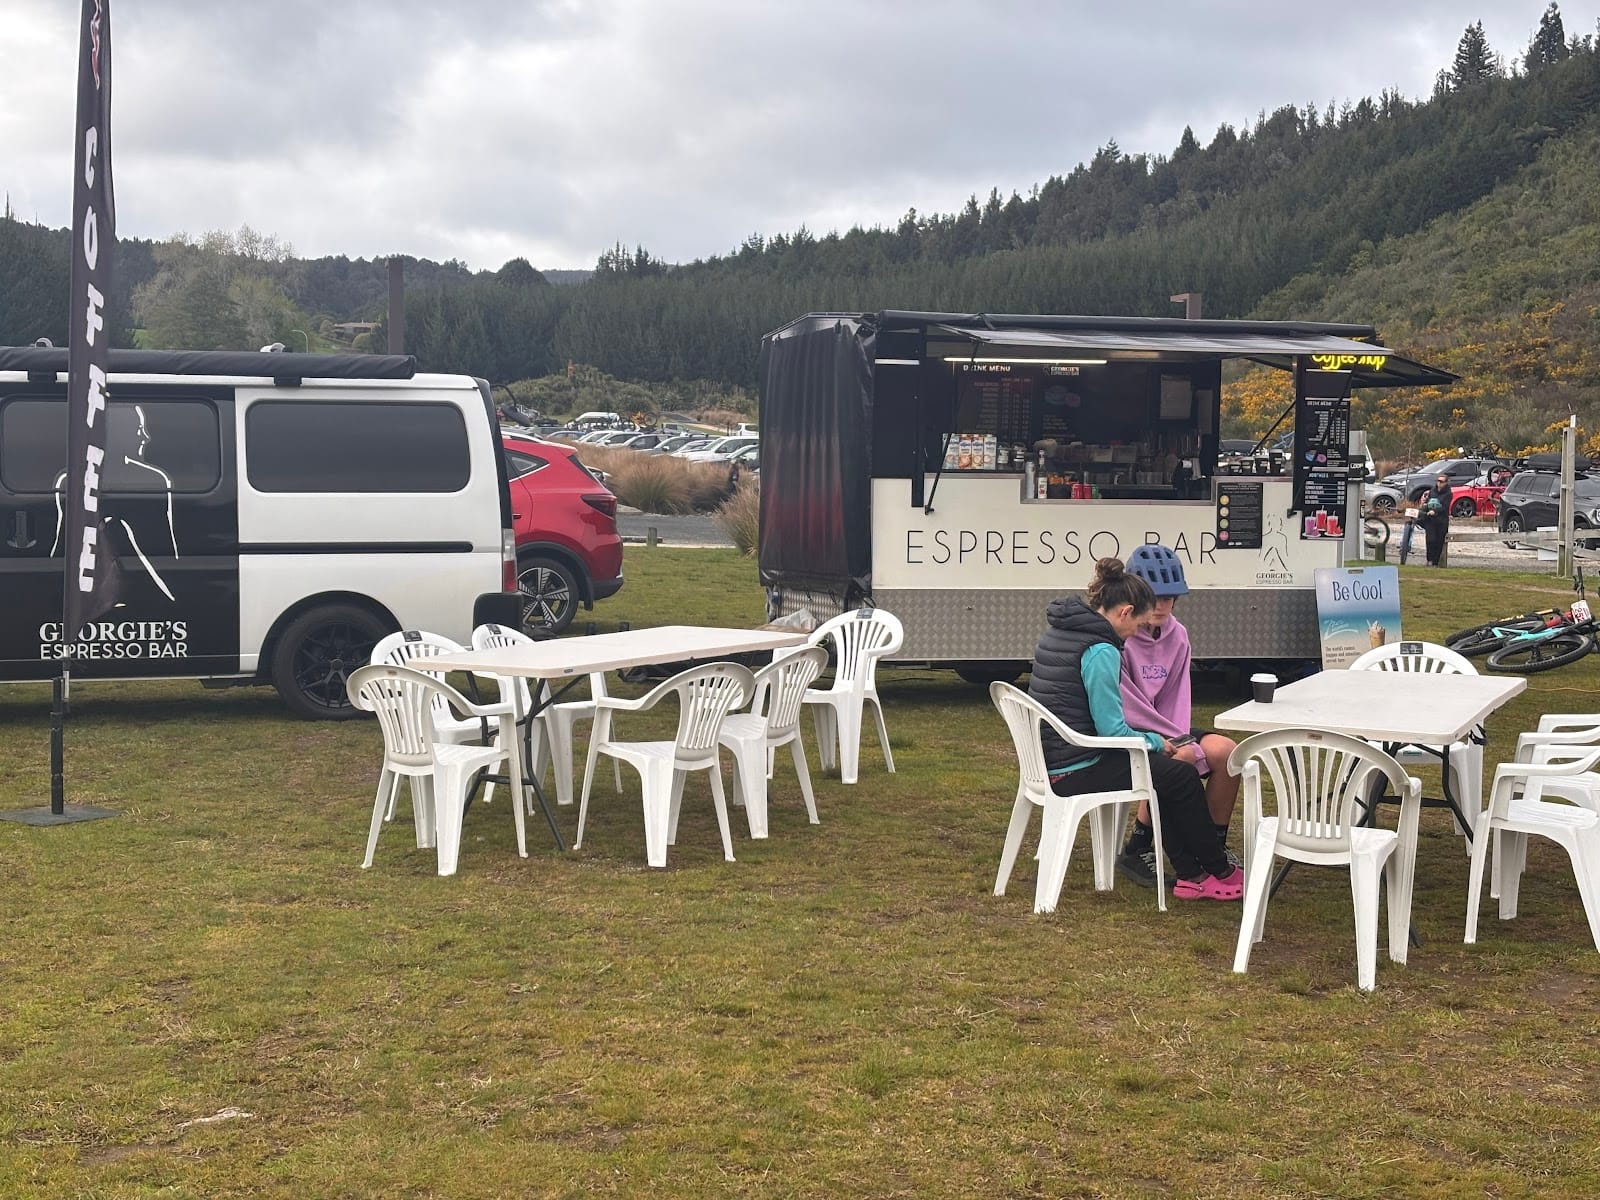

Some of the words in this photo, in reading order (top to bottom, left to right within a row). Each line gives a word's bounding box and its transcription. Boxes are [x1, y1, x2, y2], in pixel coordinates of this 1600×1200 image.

[79, 126, 105, 592] COFFEE
[907, 530, 1120, 565] ESPRESSO
[1332, 581, 1350, 601] Be
[1353, 579, 1383, 600] Cool
[39, 620, 188, 642] GORGIE'S
[40, 642, 142, 660] ESPRESSO
[149, 642, 188, 658] BAR
